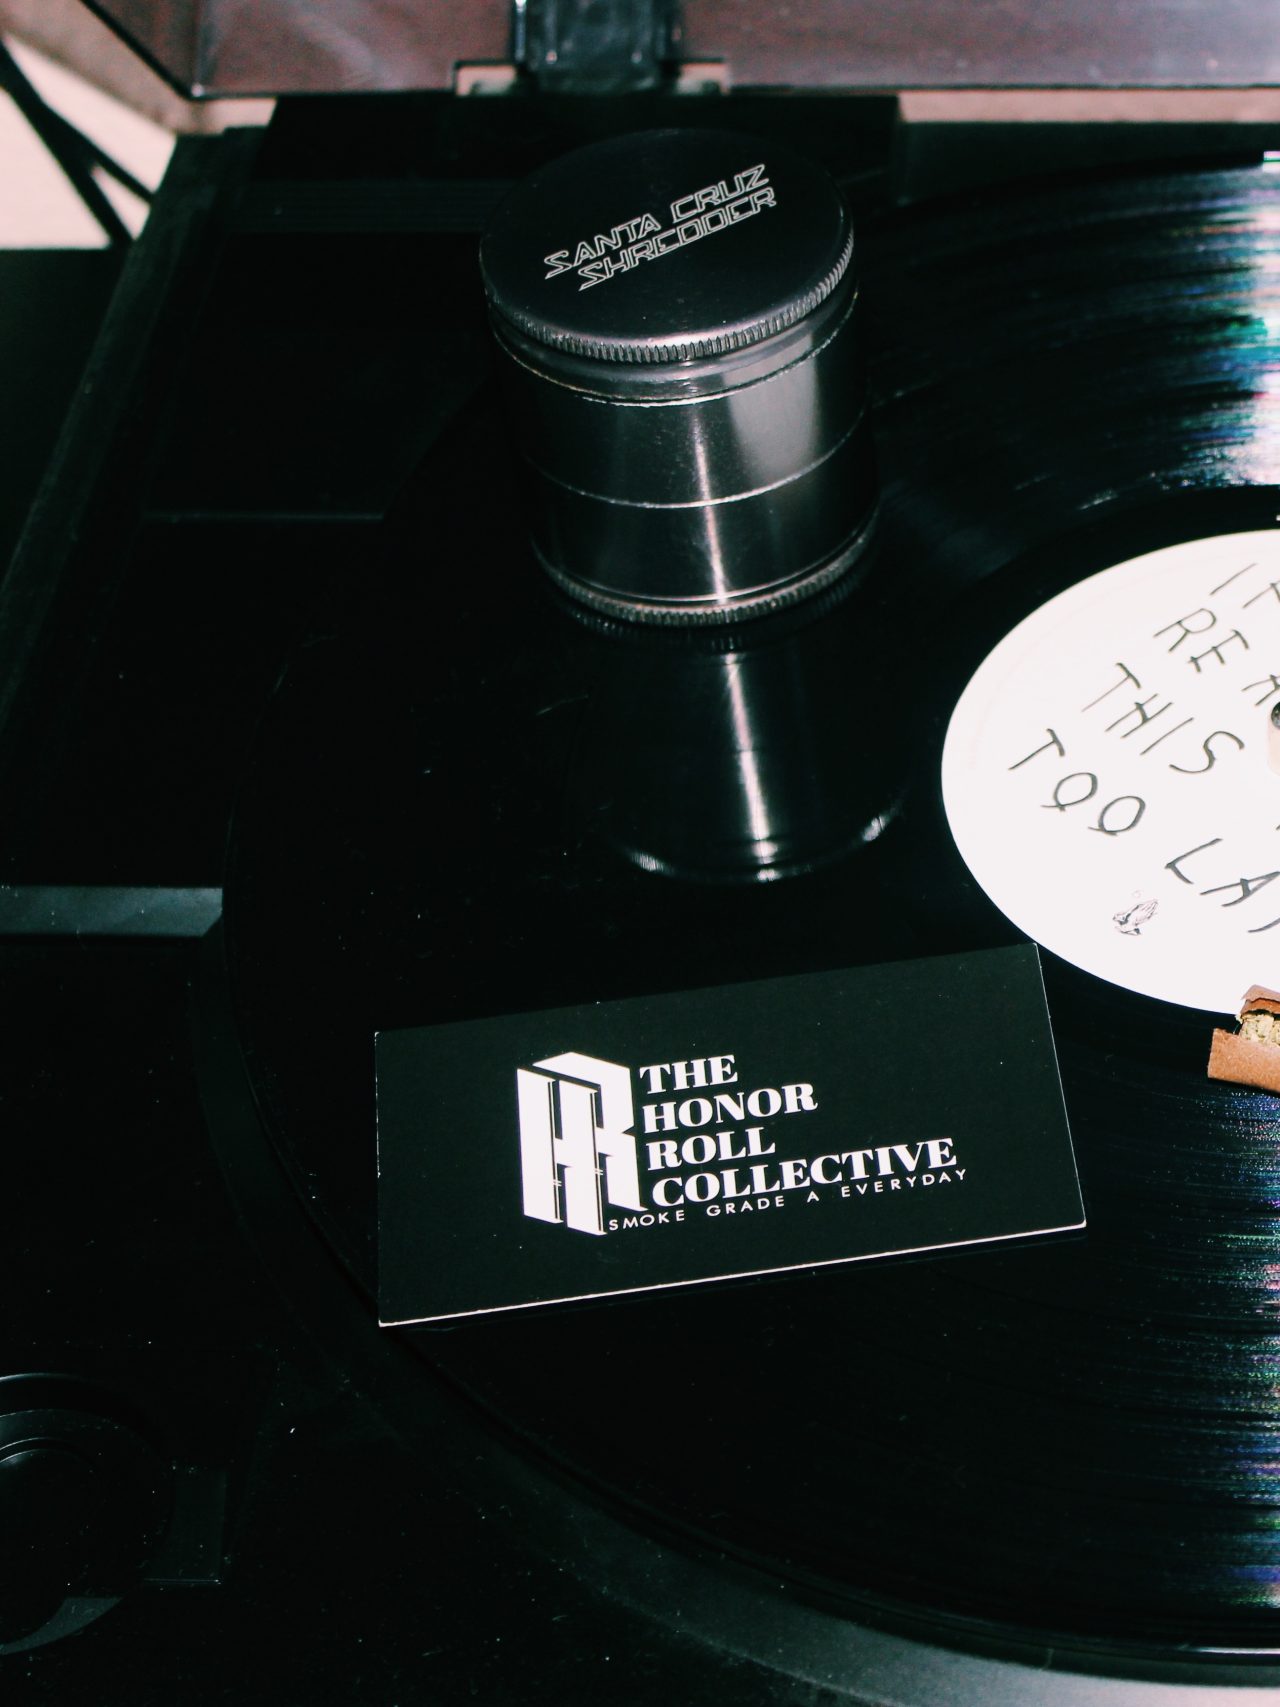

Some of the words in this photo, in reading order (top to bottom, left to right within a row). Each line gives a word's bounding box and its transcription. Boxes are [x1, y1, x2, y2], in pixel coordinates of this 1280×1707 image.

[544, 213, 661, 280] SANTA
[671, 164, 769, 224] CRUZ
[578, 187, 777, 291] SHREDDER
[1081, 662, 1246, 776] THIS
[1007, 727, 1148, 837] TOO
[639, 1054, 739, 1095] THE
[642, 1083, 819, 1134] HONOR
[646, 1126, 776, 1171] ROLL
[652, 1138, 957, 1208] COLLECTIVE
[608, 1210, 686, 1231] SMOKE
[706, 1195, 785, 1217] GRADE
[806, 1190, 820, 1203] A
[841, 1168, 967, 1198] EVERYDAY
